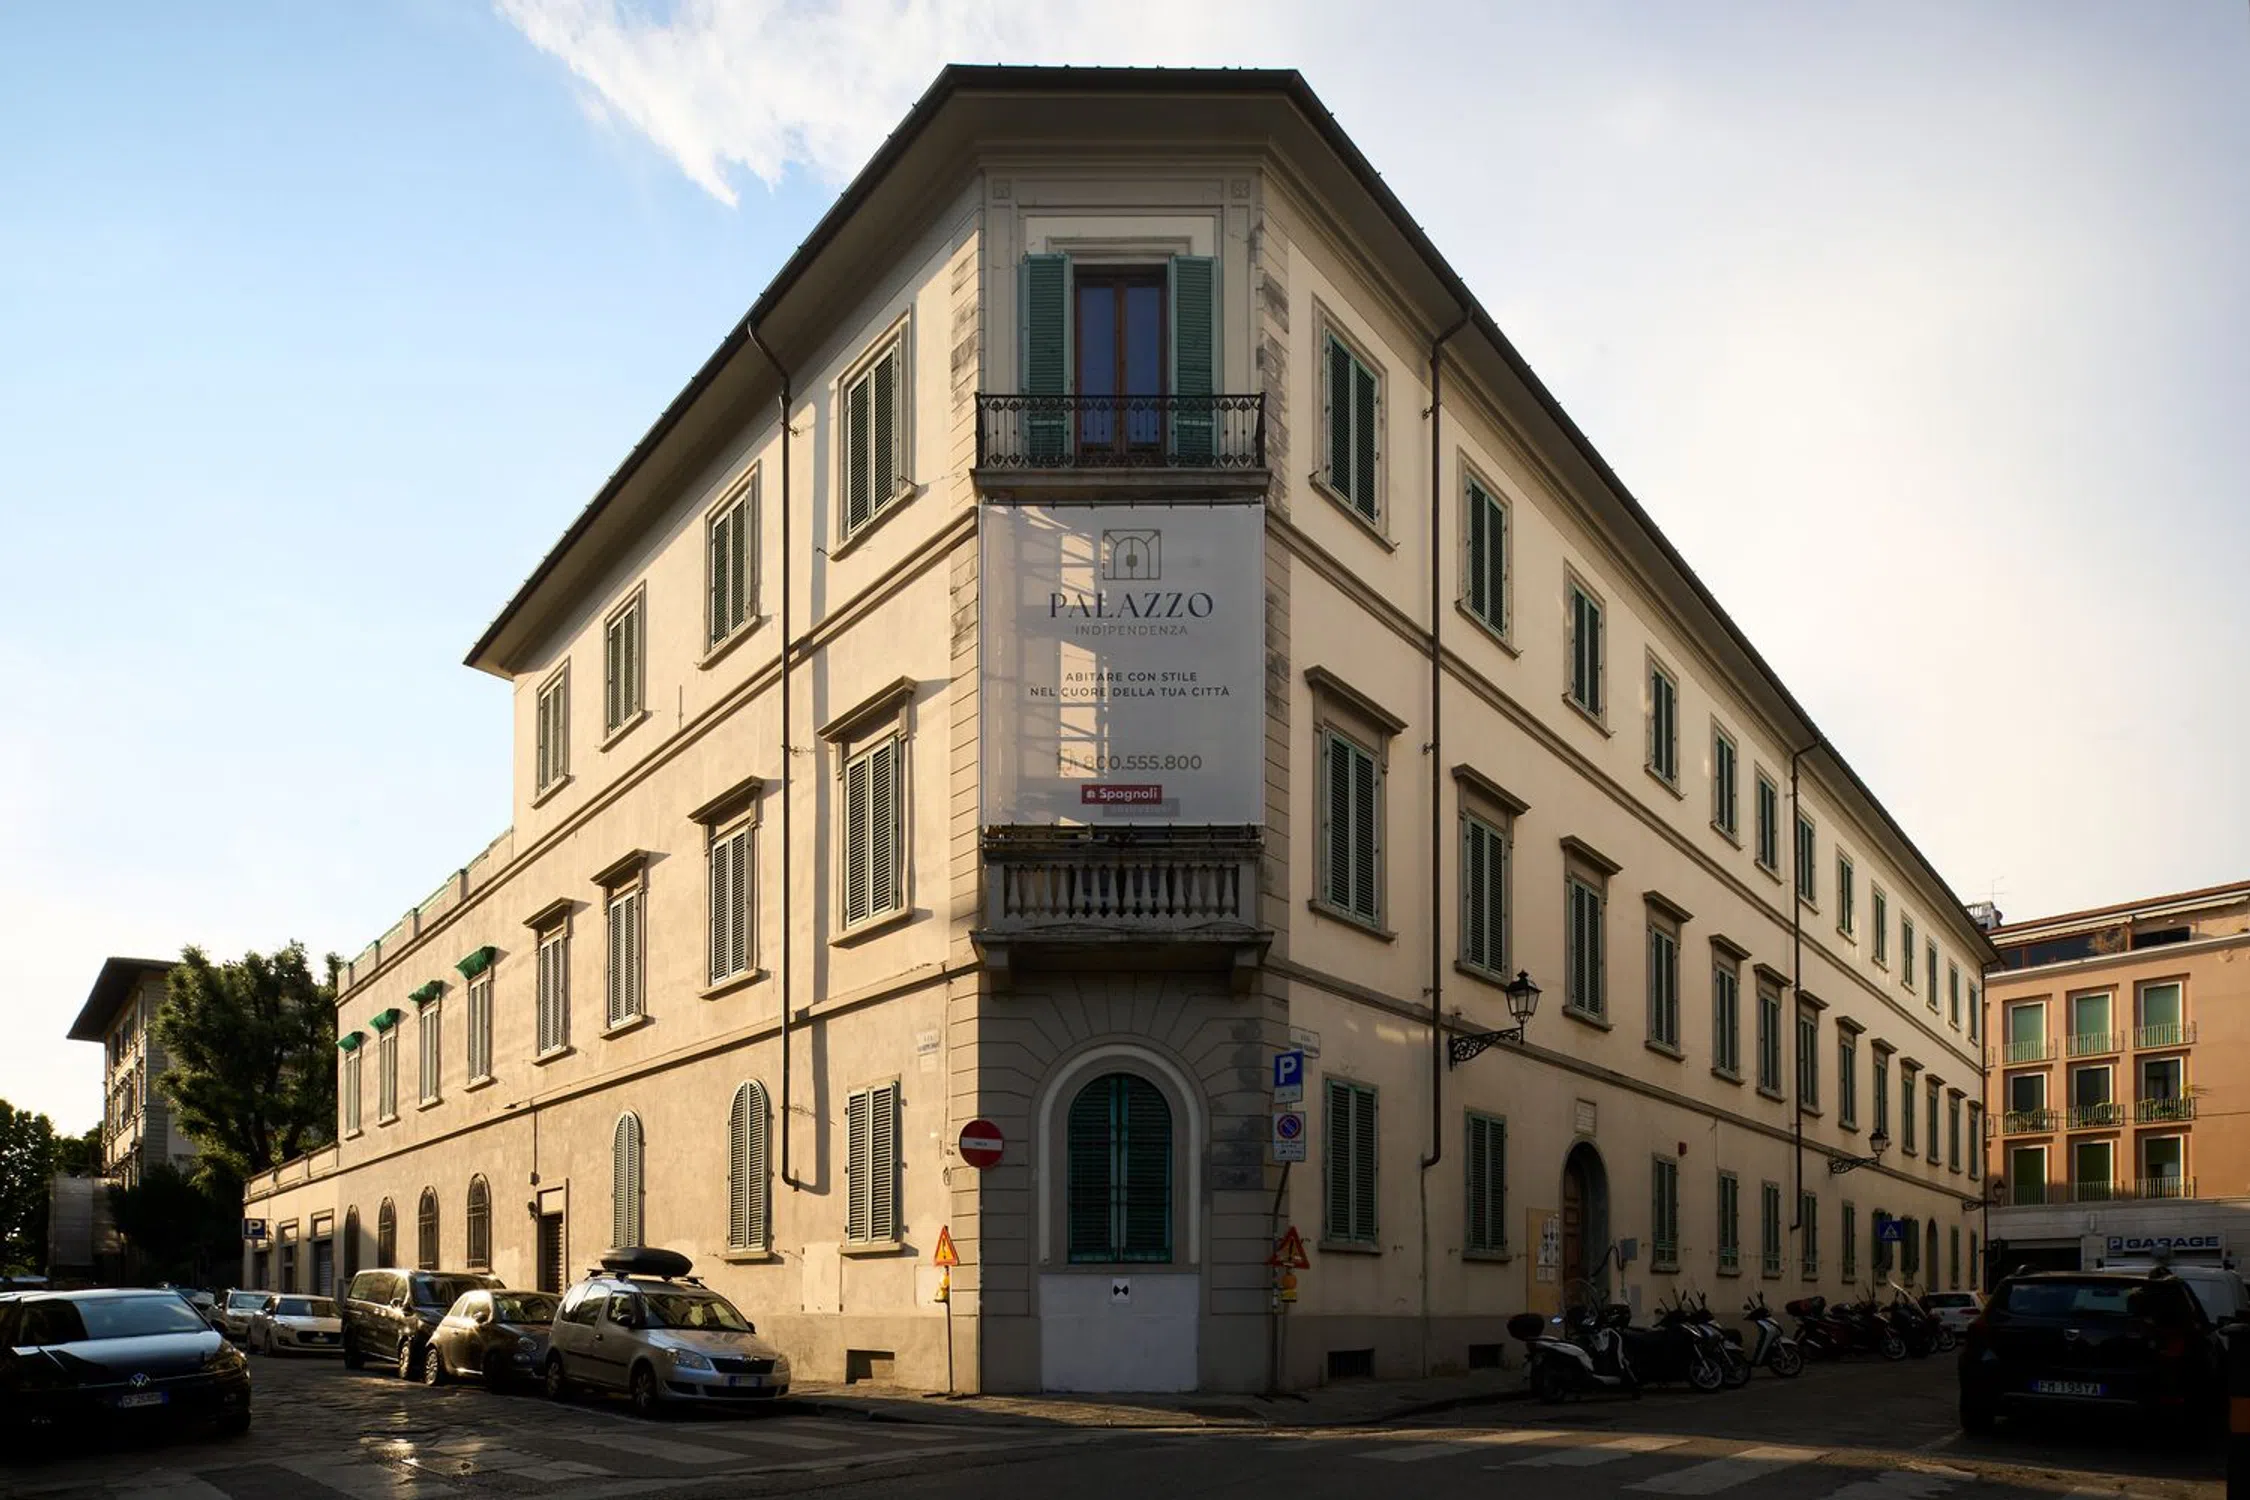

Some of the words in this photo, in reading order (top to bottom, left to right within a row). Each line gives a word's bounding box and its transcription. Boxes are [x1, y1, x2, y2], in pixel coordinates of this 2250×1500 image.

[1050, 592, 1213, 618] PALAZZO
[1075, 625, 1188, 636] INDIPENDENZA
[1065, 672, 1123, 682] ABITARE
[1127, 672, 1157, 682] CON
[1161, 672, 1197, 682] STILE
[1030, 687, 1056, 697] NEL
[1061, 687, 1106, 697] CUORE
[1112, 687, 1155, 697] DELLA
[1160, 687, 1187, 697] TUA
[1192, 686, 1230, 697] CITTÀ
[1084, 754, 1203, 771] 800.555.800
[1099, 787, 1158, 802] Spagnoli
[1278, 1056, 1297, 1084] P
[247, 1220, 262, 1235] P
